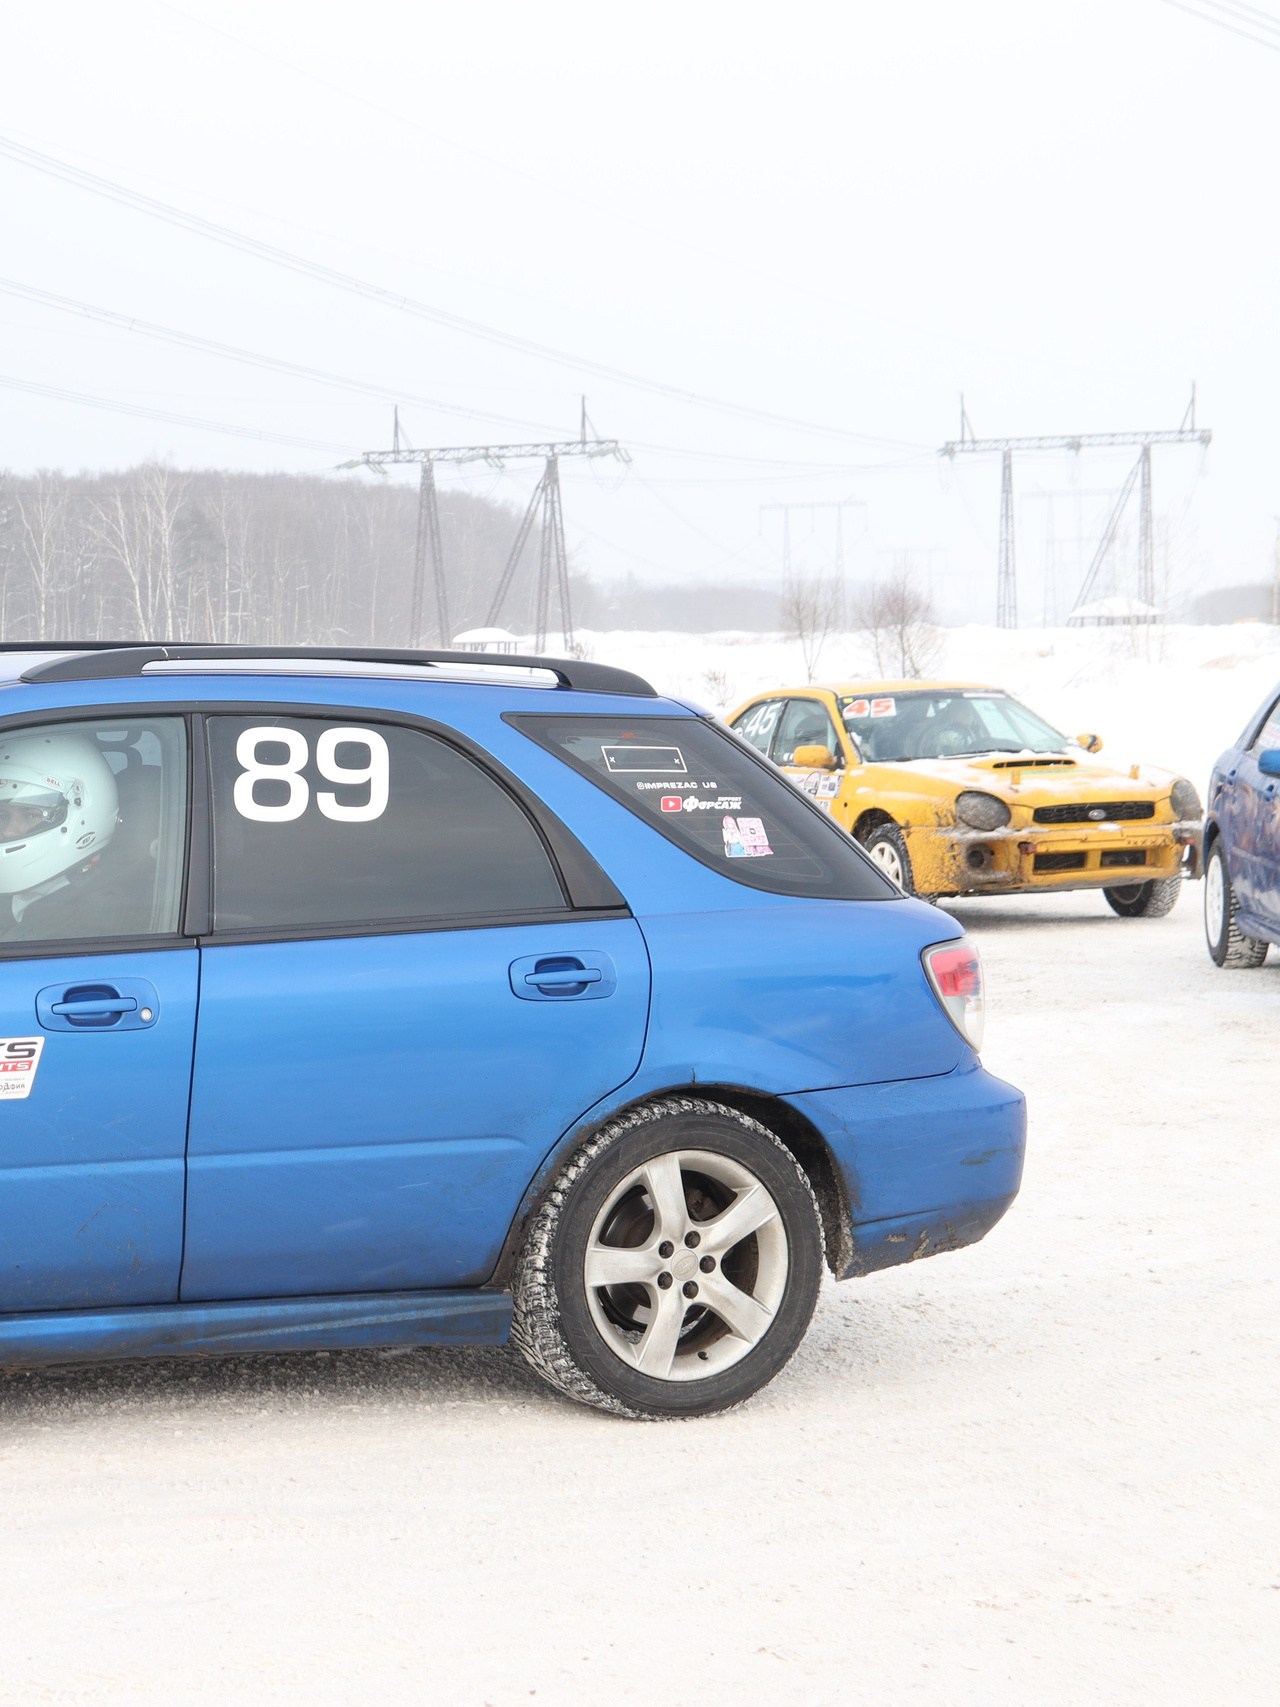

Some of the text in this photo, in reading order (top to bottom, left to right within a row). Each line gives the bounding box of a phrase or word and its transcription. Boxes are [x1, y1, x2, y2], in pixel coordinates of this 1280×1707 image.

[845, 700, 893, 714] 45
[745, 702, 782, 737] 45
[46, 778, 61, 787] BELL
[233, 726, 390, 823] 89
